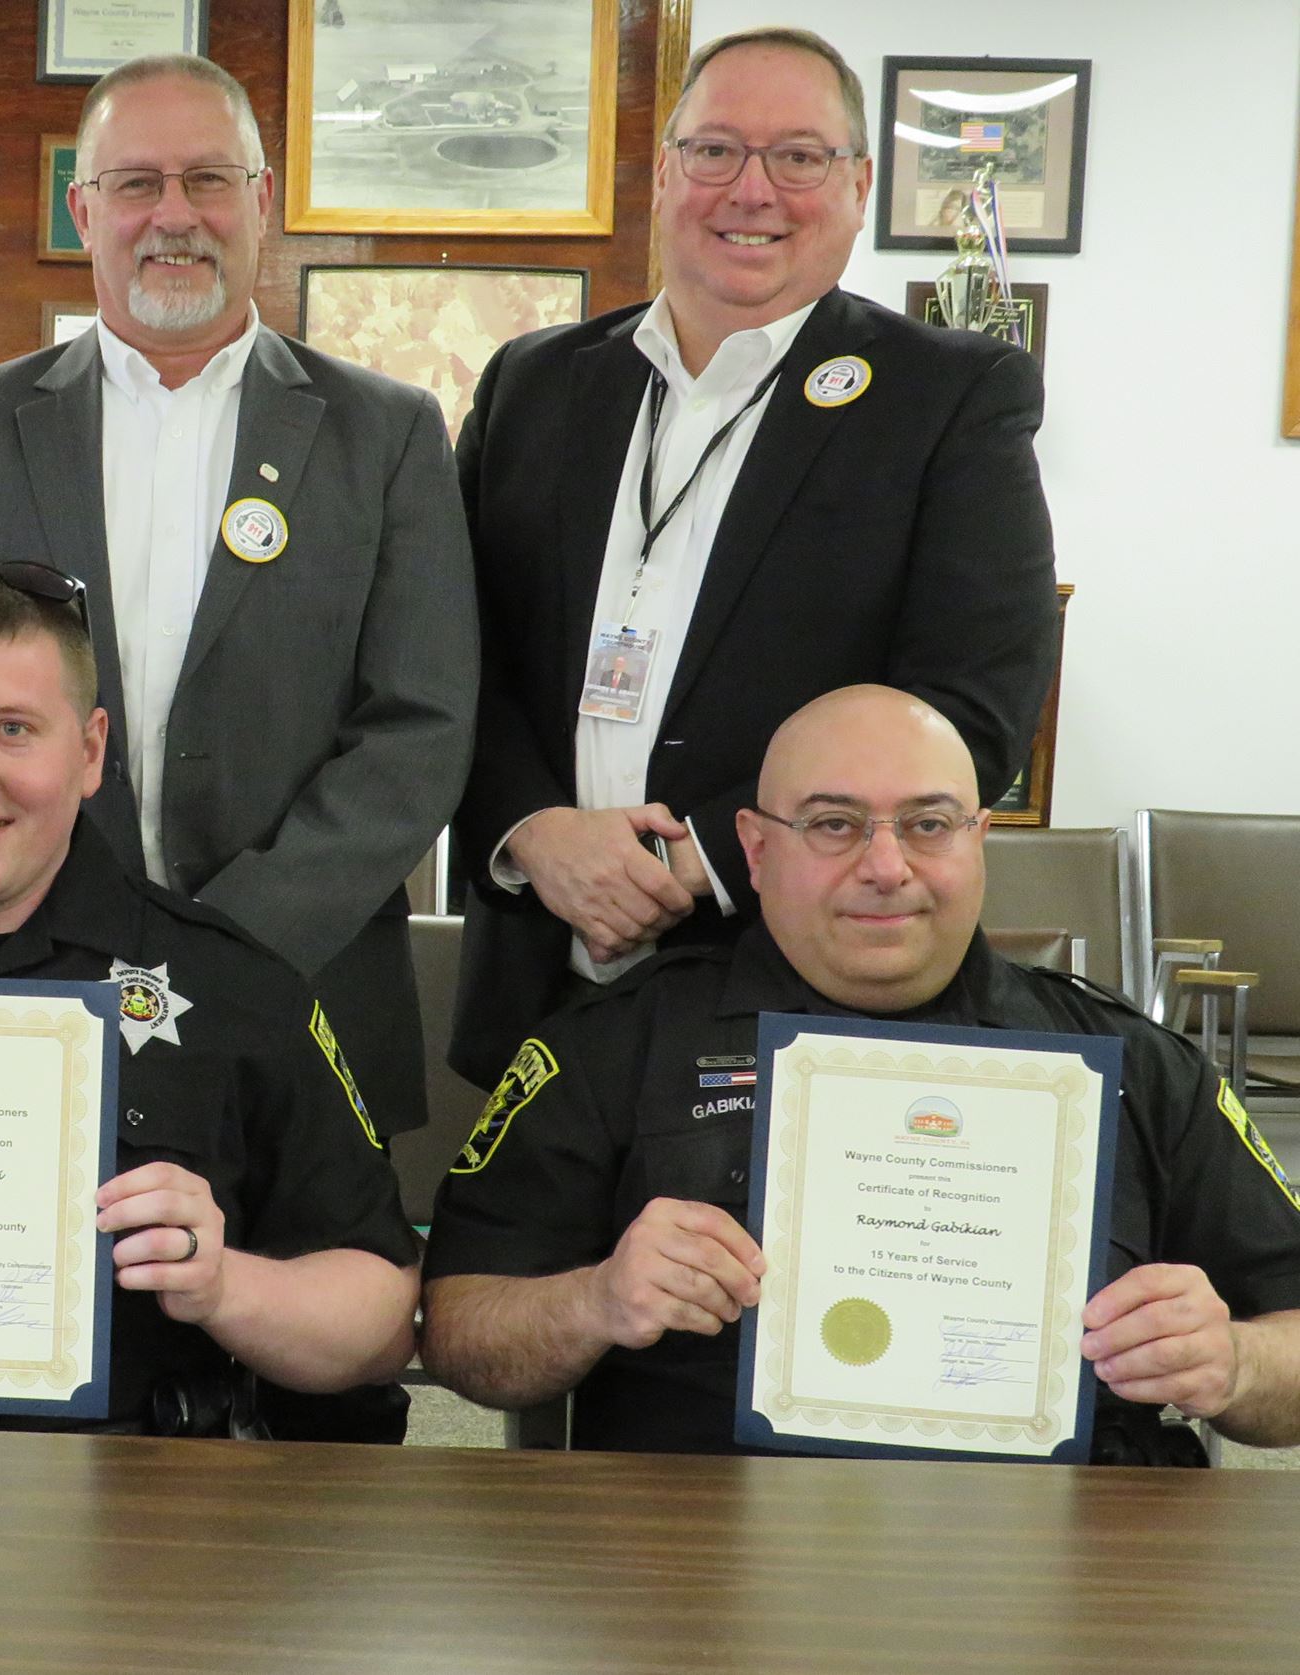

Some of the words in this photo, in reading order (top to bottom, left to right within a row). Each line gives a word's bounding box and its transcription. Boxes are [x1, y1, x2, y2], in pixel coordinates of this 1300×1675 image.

[73, 8, 99, 16] Wayne
[102, 8, 129, 17] County
[132, 8, 175, 18] Employees
[247, 523, 263, 537] 911
[150, 992, 169, 1030] DEPARTMENT
[845, 1150, 882, 1163] Wayne
[886, 1154, 926, 1168] County
[929, 1158, 1018, 1174] Commissioners
[858, 1182, 915, 1197] Certificate
[918, 1188, 929, 1197] of
[932, 1189, 1000, 1203] Recognition
[856, 1214, 929, 1230] Raymond
[931, 1221, 1002, 1236] Gabikian
[871, 1250, 884, 1259] 15
[887, 1251, 918, 1263] Years
[922, 1254, 933, 1263] of
[936, 1255, 978, 1268] Service
[834, 1265, 844, 1274] to
[848, 1266, 865, 1275] the
[869, 1267, 913, 1280] Citizens
[916, 1272, 928, 1282] of
[931, 1273, 968, 1286] Wayne
[972, 1277, 1012, 1290] County
[990, 1319, 1037, 1328] Commissioners
